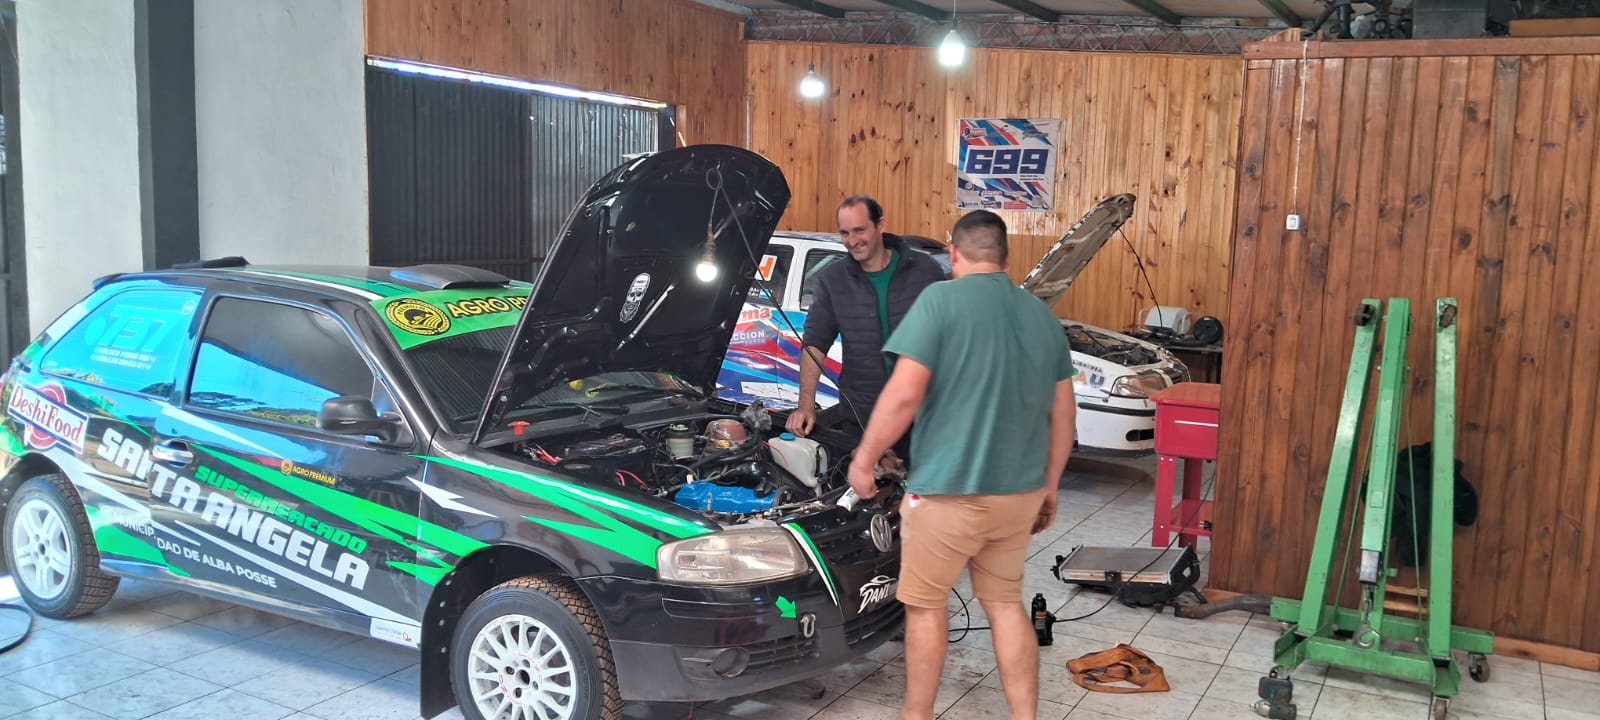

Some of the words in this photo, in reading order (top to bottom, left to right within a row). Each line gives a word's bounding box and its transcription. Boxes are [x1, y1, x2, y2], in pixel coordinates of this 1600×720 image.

[966, 149, 1049, 174] 699
[446, 297, 512, 318] AGRO
[731, 330, 766, 342] CCION
[10, 386, 83, 443] DeshiFood
[97, 428, 201, 514] SANTA
[201, 492, 370, 590] ANGELA
[194, 465, 368, 554] SUPERMERCADO
[183, 547, 200, 562] DE
[203, 554, 235, 574] ALBA
[236, 565, 277, 588] POSSE
